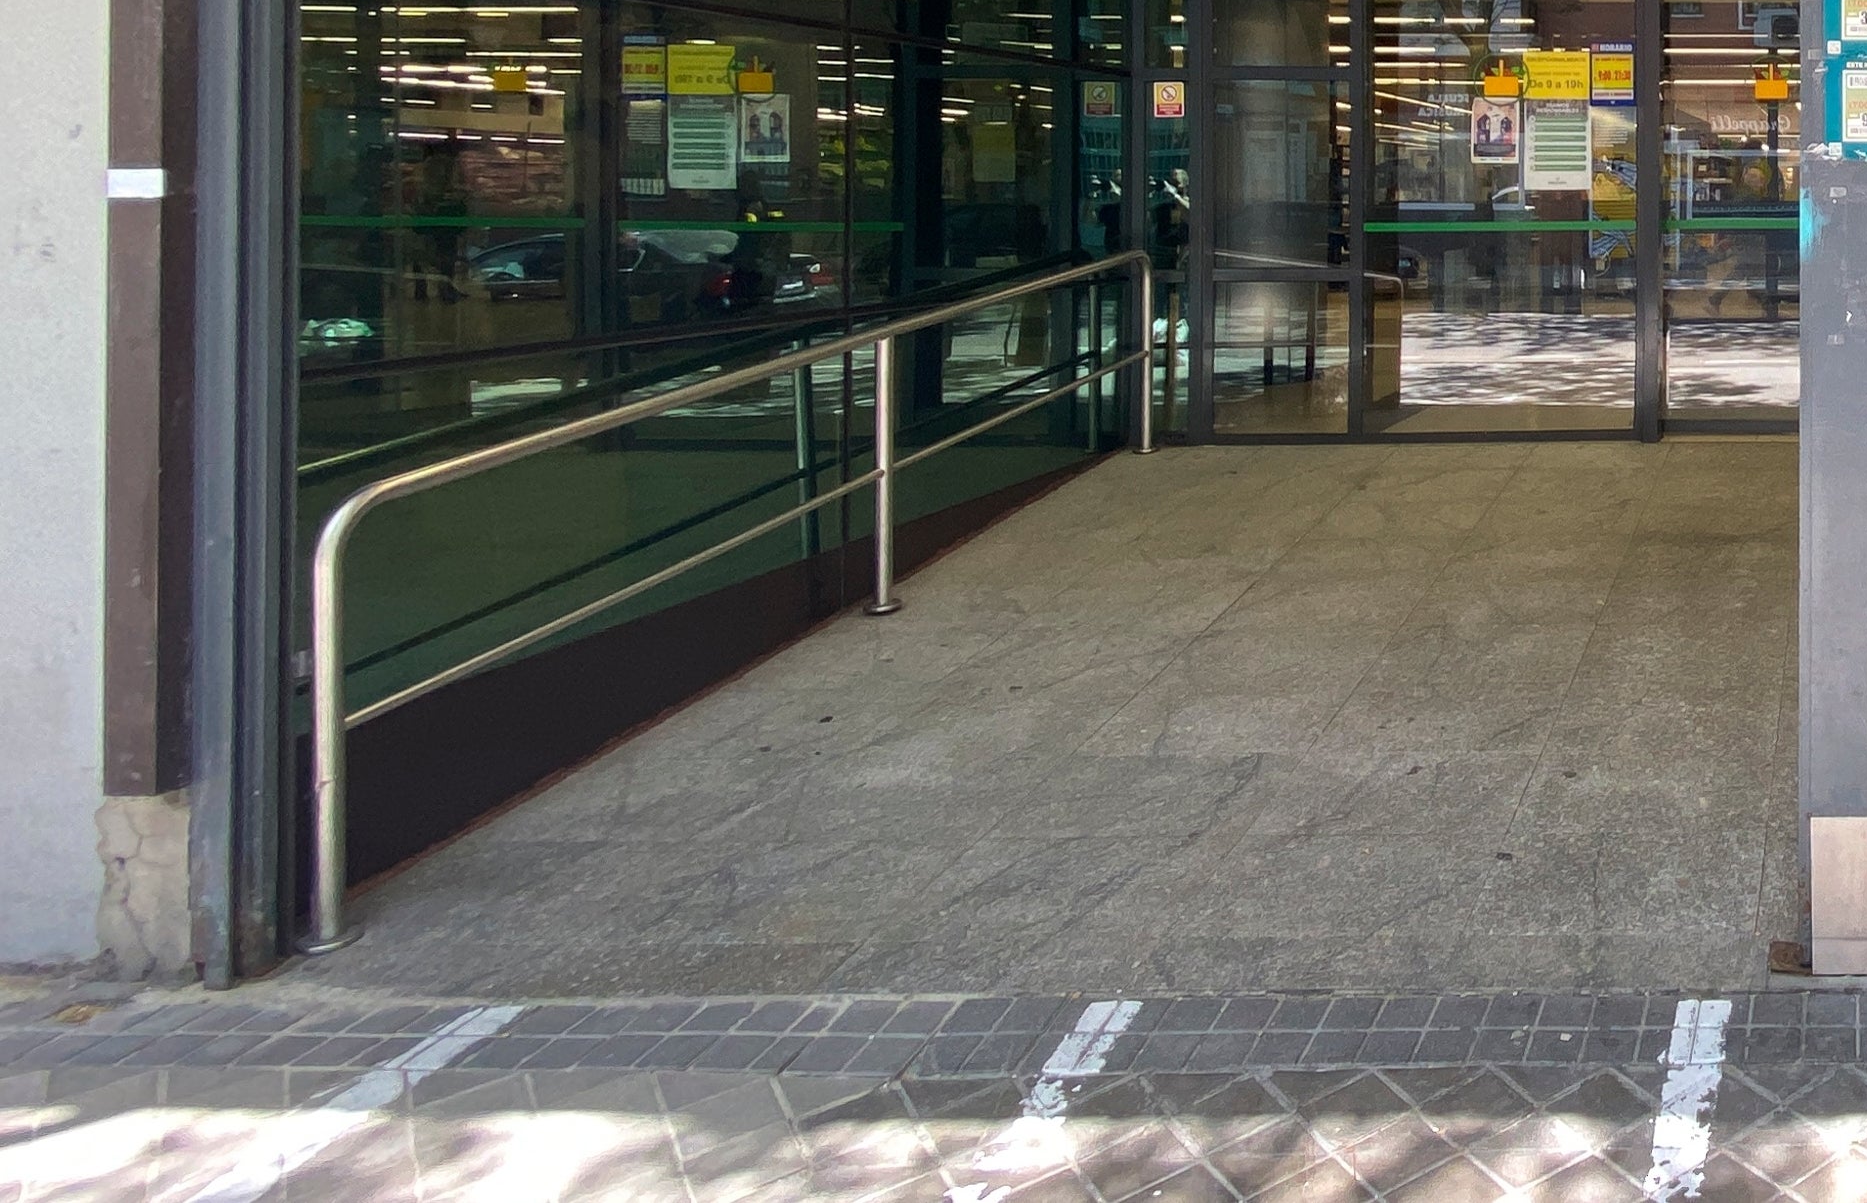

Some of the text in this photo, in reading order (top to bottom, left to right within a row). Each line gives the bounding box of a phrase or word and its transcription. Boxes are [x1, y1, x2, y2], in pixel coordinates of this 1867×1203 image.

[1599, 44, 1633, 52] HORARIO
[1529, 79, 1543, 88] De
[1546, 79, 1553, 88] 9
[1565, 79, 1584, 88] 19h
